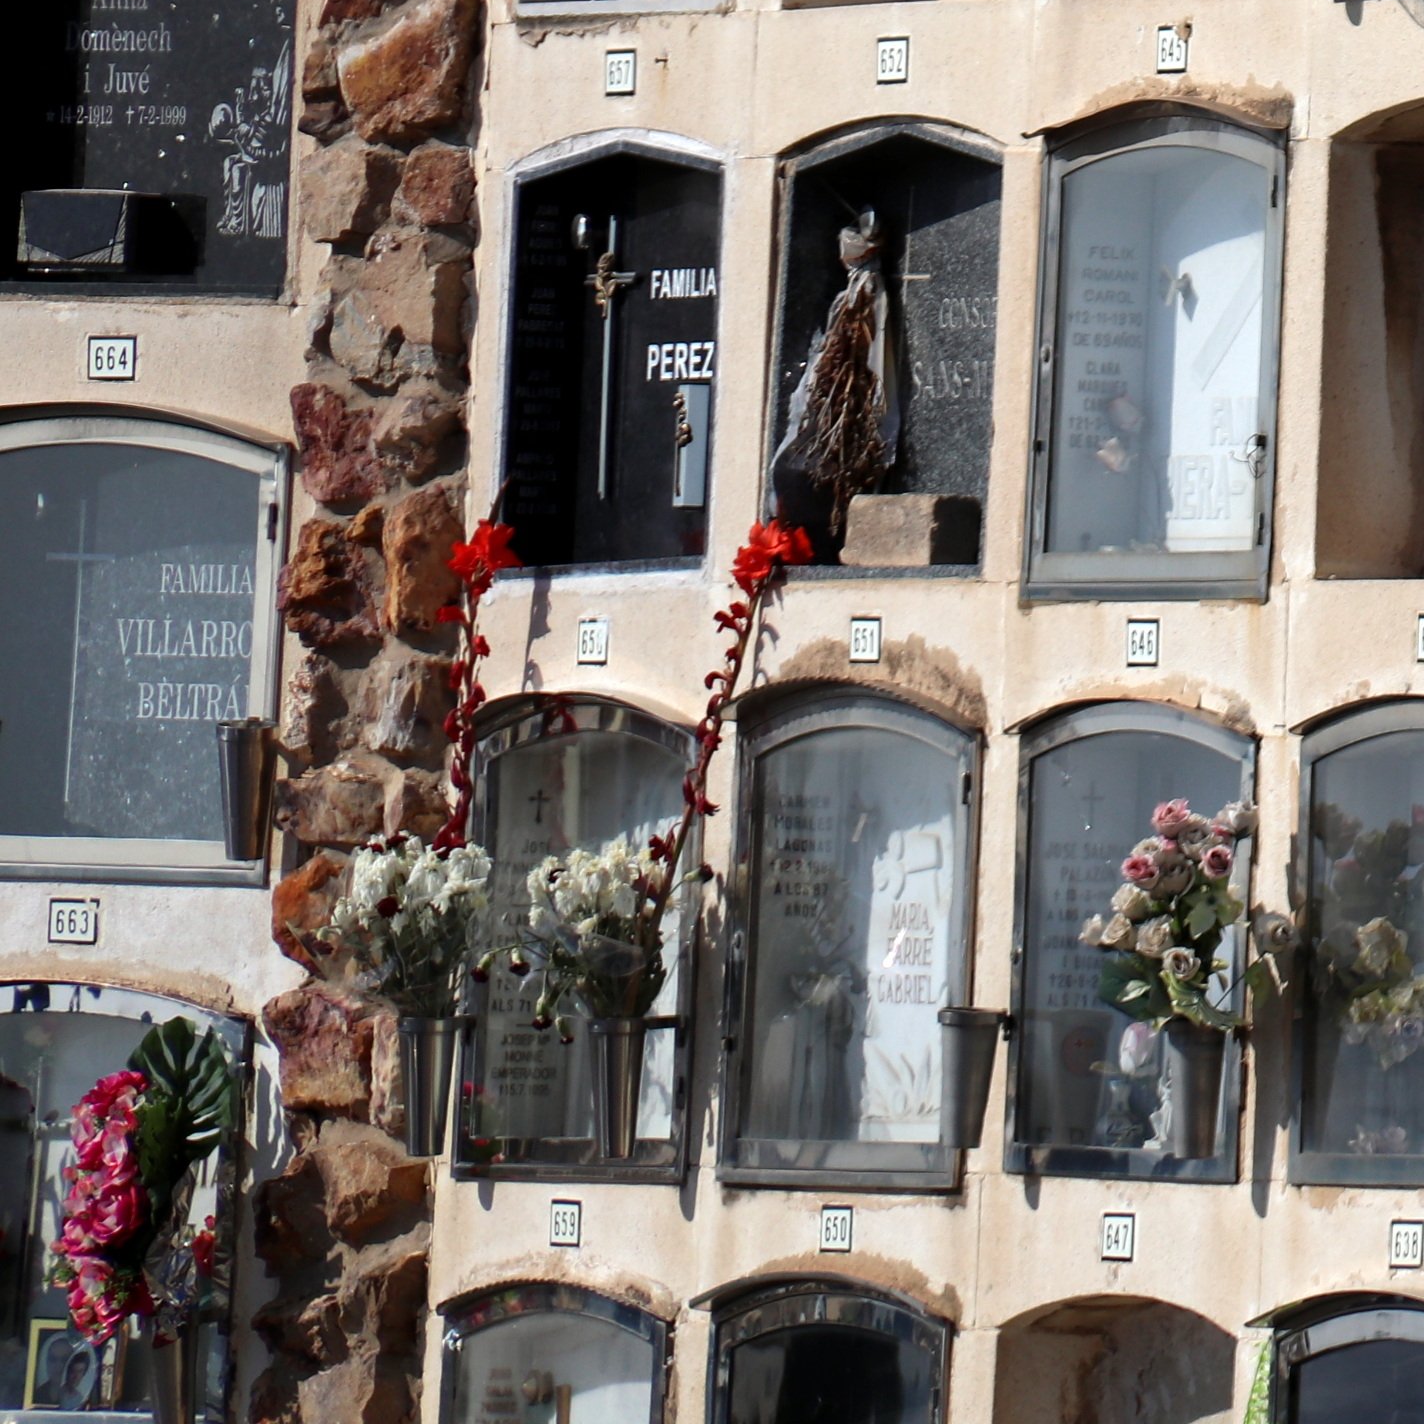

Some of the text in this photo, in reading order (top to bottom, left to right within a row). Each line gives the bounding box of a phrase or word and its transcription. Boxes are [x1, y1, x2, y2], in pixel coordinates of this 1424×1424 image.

[880, 47, 904, 74] 652
[1160, 36, 1183, 63] 645
[104, 63, 150, 94] Juvé
[608, 59, 631, 86] 657
[650, 268, 717, 299] FAMILIA
[95, 345, 128, 371] 664
[647, 342, 714, 381] PEREZ
[160, 563, 255, 594] FAMILIA
[853, 627, 875, 655] 651
[1130, 629, 1154, 657] 646
[137, 675, 251, 720] BELTRÁ
[55, 909, 89, 935] 663
[554, 1210, 576, 1237] 659
[824, 1215, 847, 1243] 650
[1106, 1223, 1129, 1251] 647
[1395, 1230, 1419, 1259] 638
